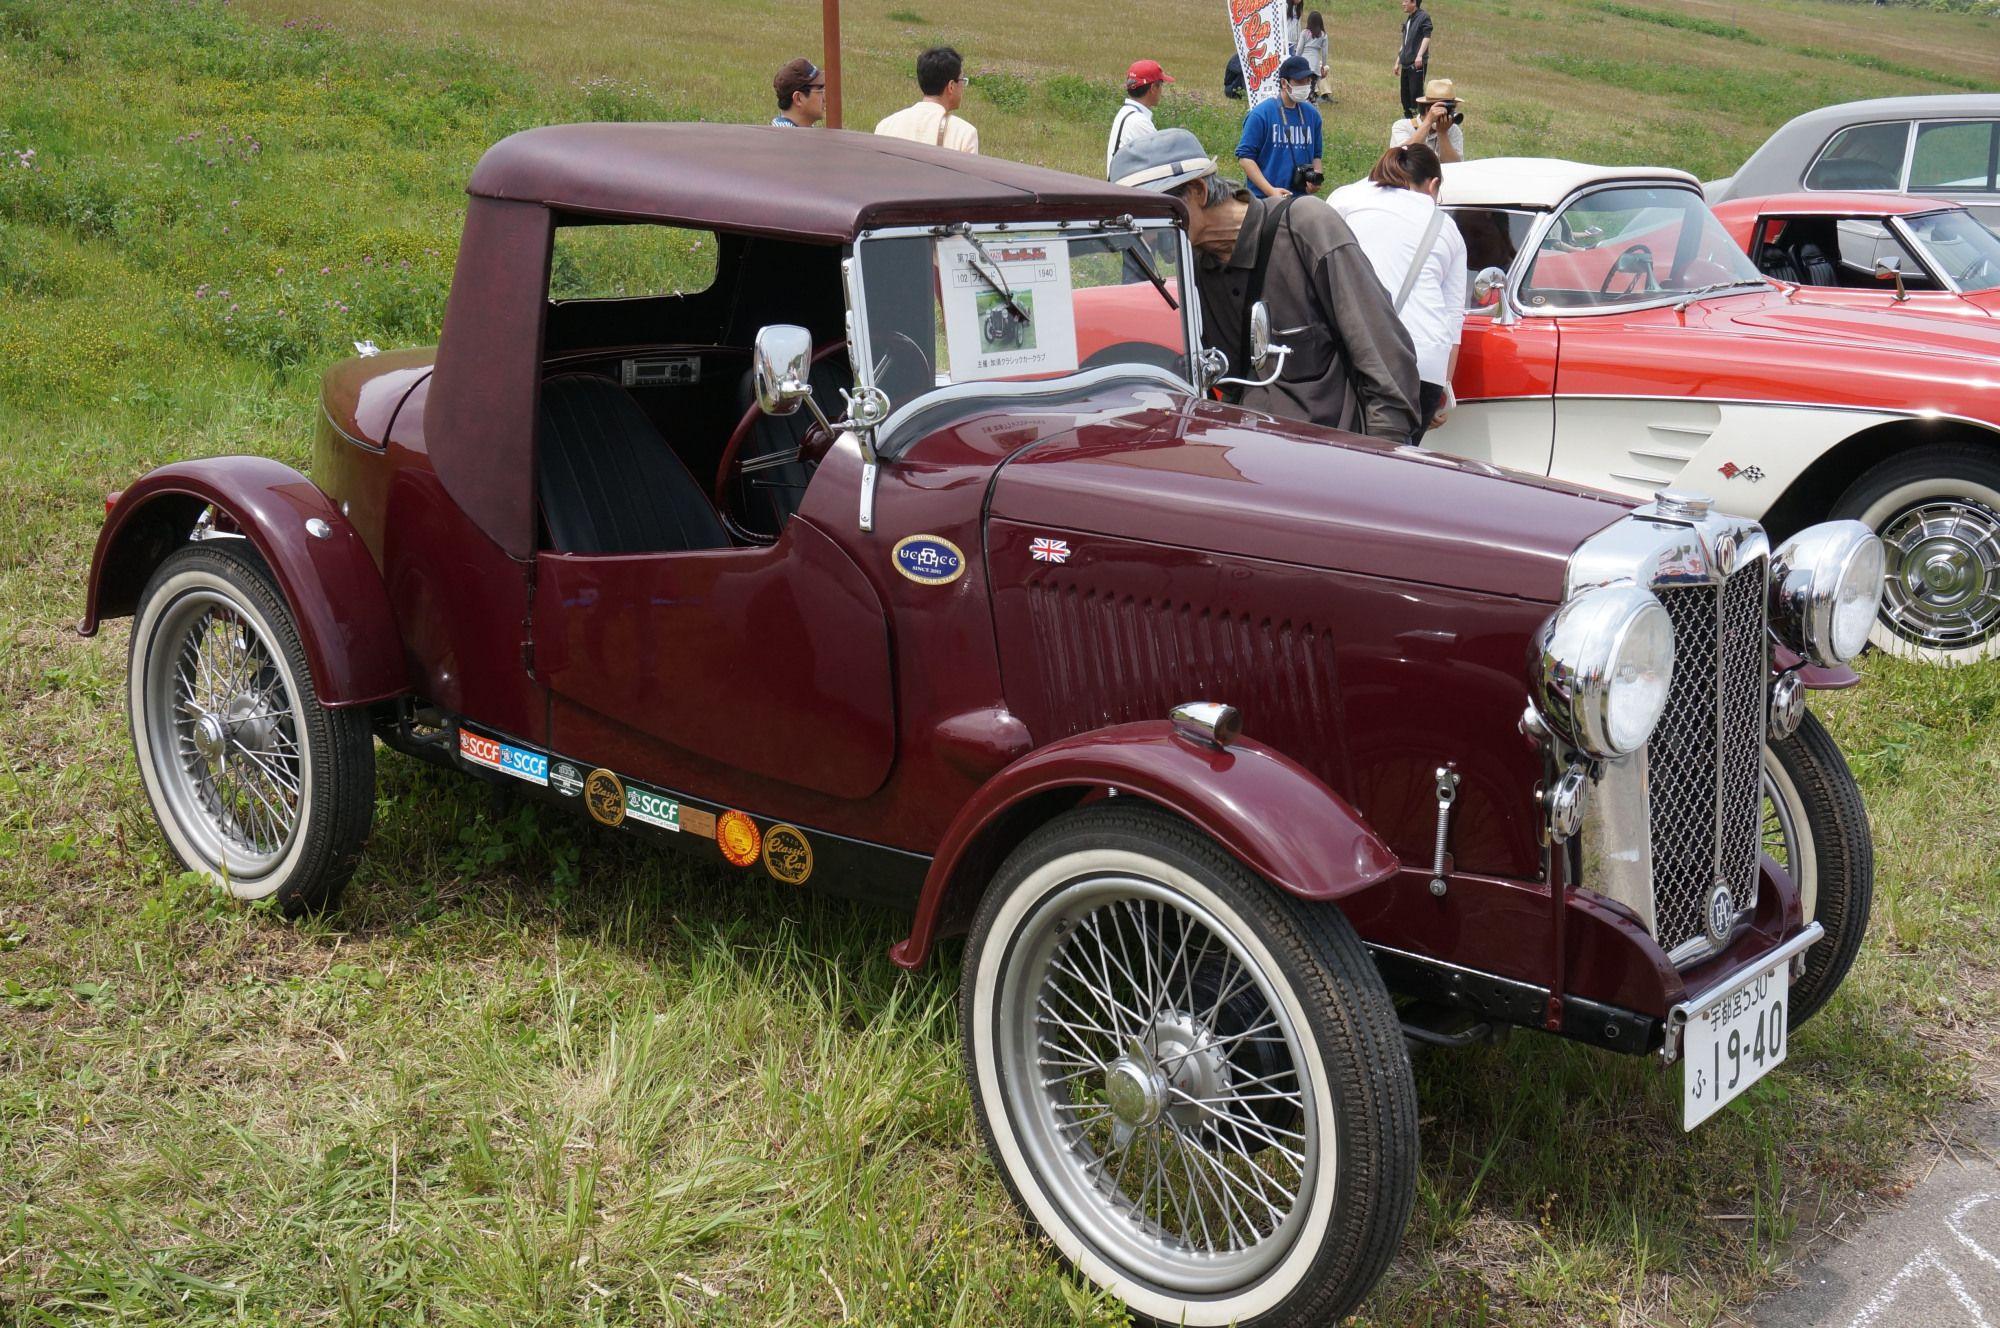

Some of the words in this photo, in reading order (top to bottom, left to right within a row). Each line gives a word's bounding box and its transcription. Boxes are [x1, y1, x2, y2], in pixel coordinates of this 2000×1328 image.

[957, 273, 968, 283] 102
[1038, 269, 1054, 279] 1940
[469, 737, 500, 761] SCCF
[513, 752, 547, 776] SCCF
[641, 795, 678, 821] SCCF
[768, 837, 808, 857] Classic
[1692, 1069, 1707, 1099] ふ
[1714, 1000, 1782, 1102] 19-40
